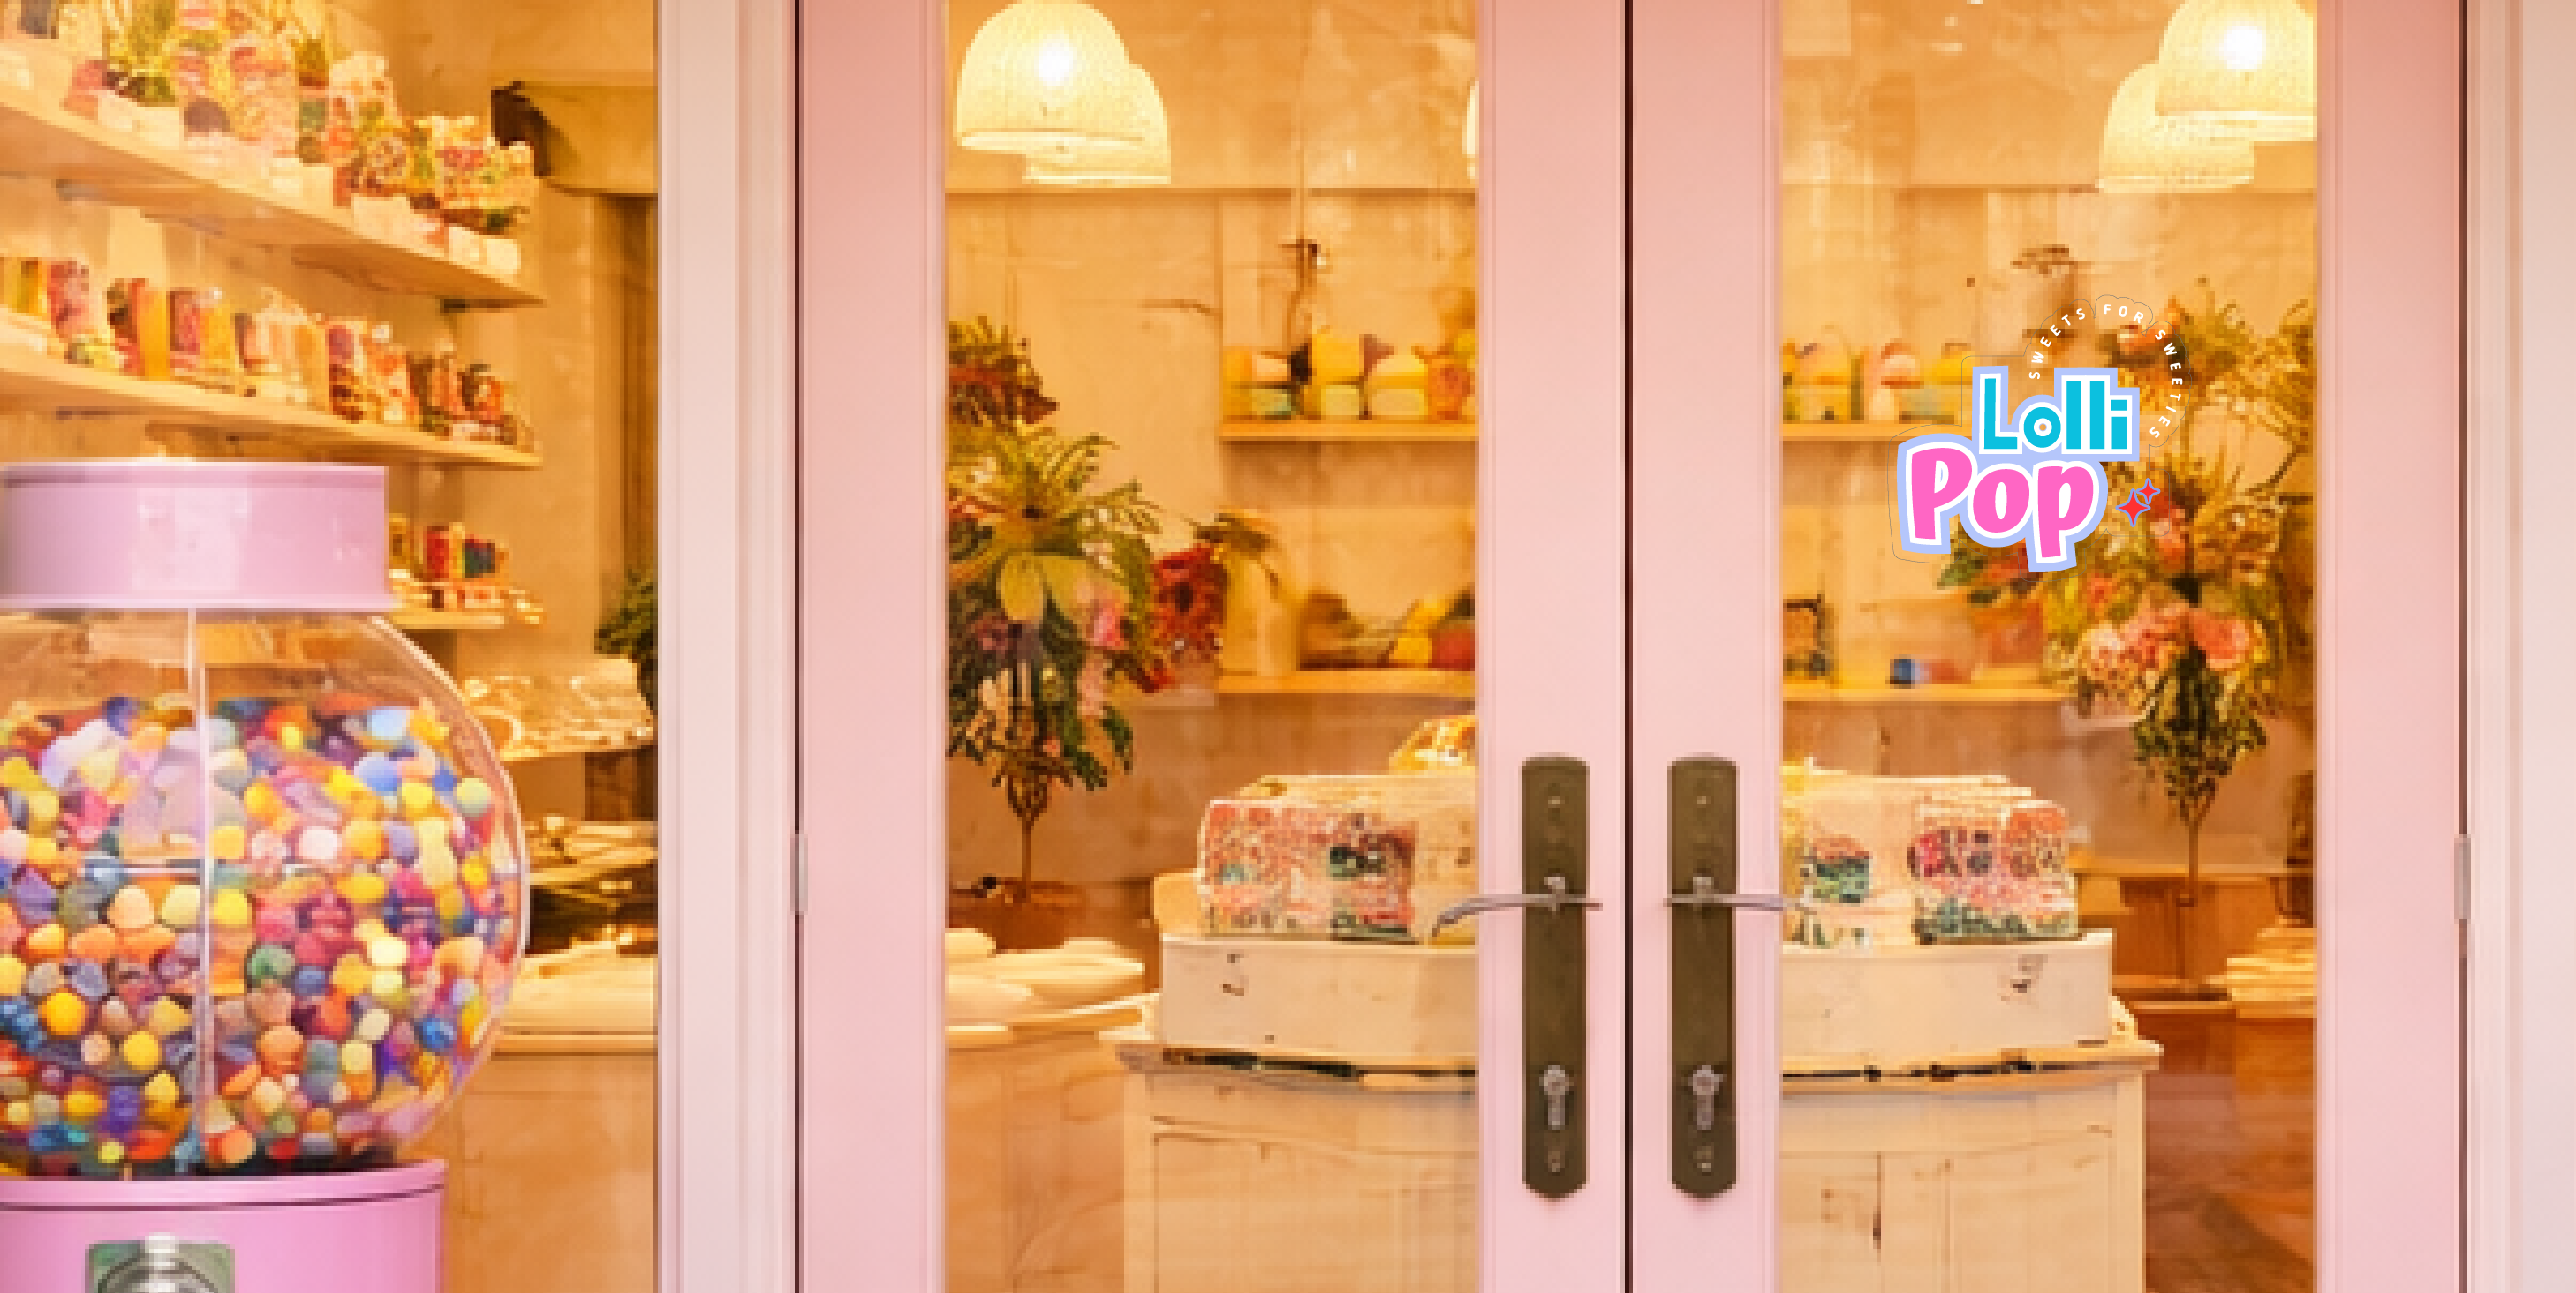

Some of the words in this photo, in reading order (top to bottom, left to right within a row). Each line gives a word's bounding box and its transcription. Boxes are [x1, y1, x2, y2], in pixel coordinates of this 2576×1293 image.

[1981, 375, 2130, 451] Lolli
[2028, 308, 2086, 380] SWEETS
[2104, 303, 2144, 323] FOR
[2149, 329, 2183, 438] SWEETIES
[1908, 444, 2096, 561] Pop
